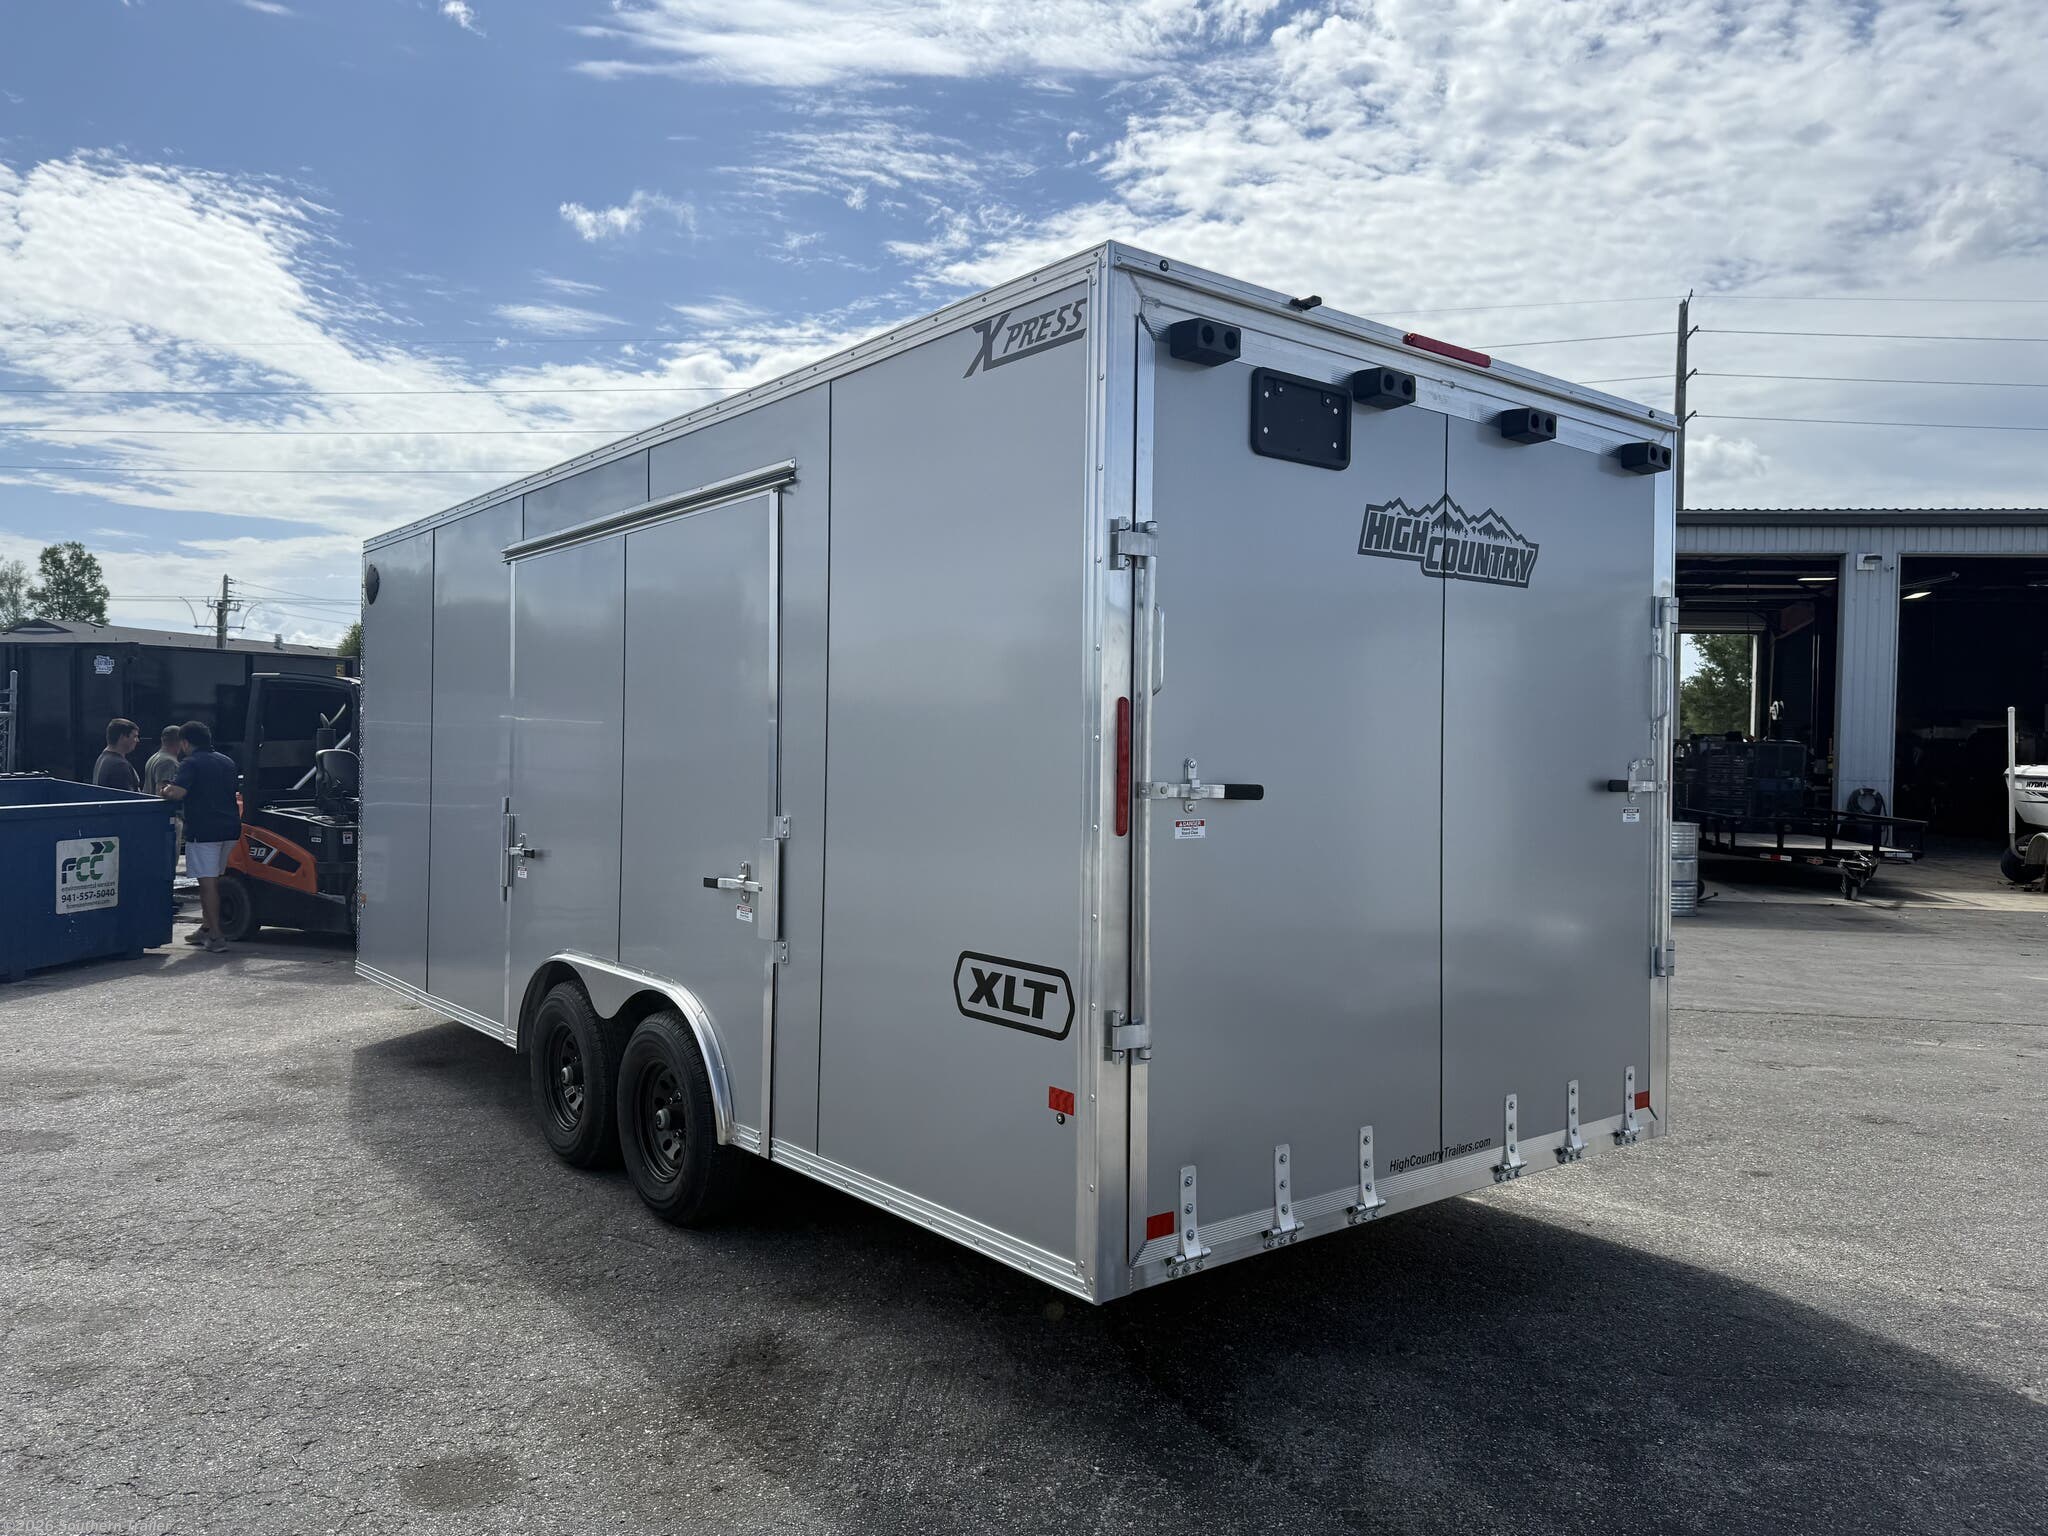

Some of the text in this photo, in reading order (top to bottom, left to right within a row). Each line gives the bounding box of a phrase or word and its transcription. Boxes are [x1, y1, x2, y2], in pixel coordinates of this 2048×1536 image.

[963, 298, 1087, 379] XPRESS
[1364, 512, 1430, 554] HIGH
[1425, 536, 1535, 581] COUNTRY
[61, 854, 104, 885] FCC
[61, 888, 116, 904] 941-557-5040
[968, 966, 1058, 1020] XLT
[1389, 1137, 1491, 1173] HighCountryTrailers.com
